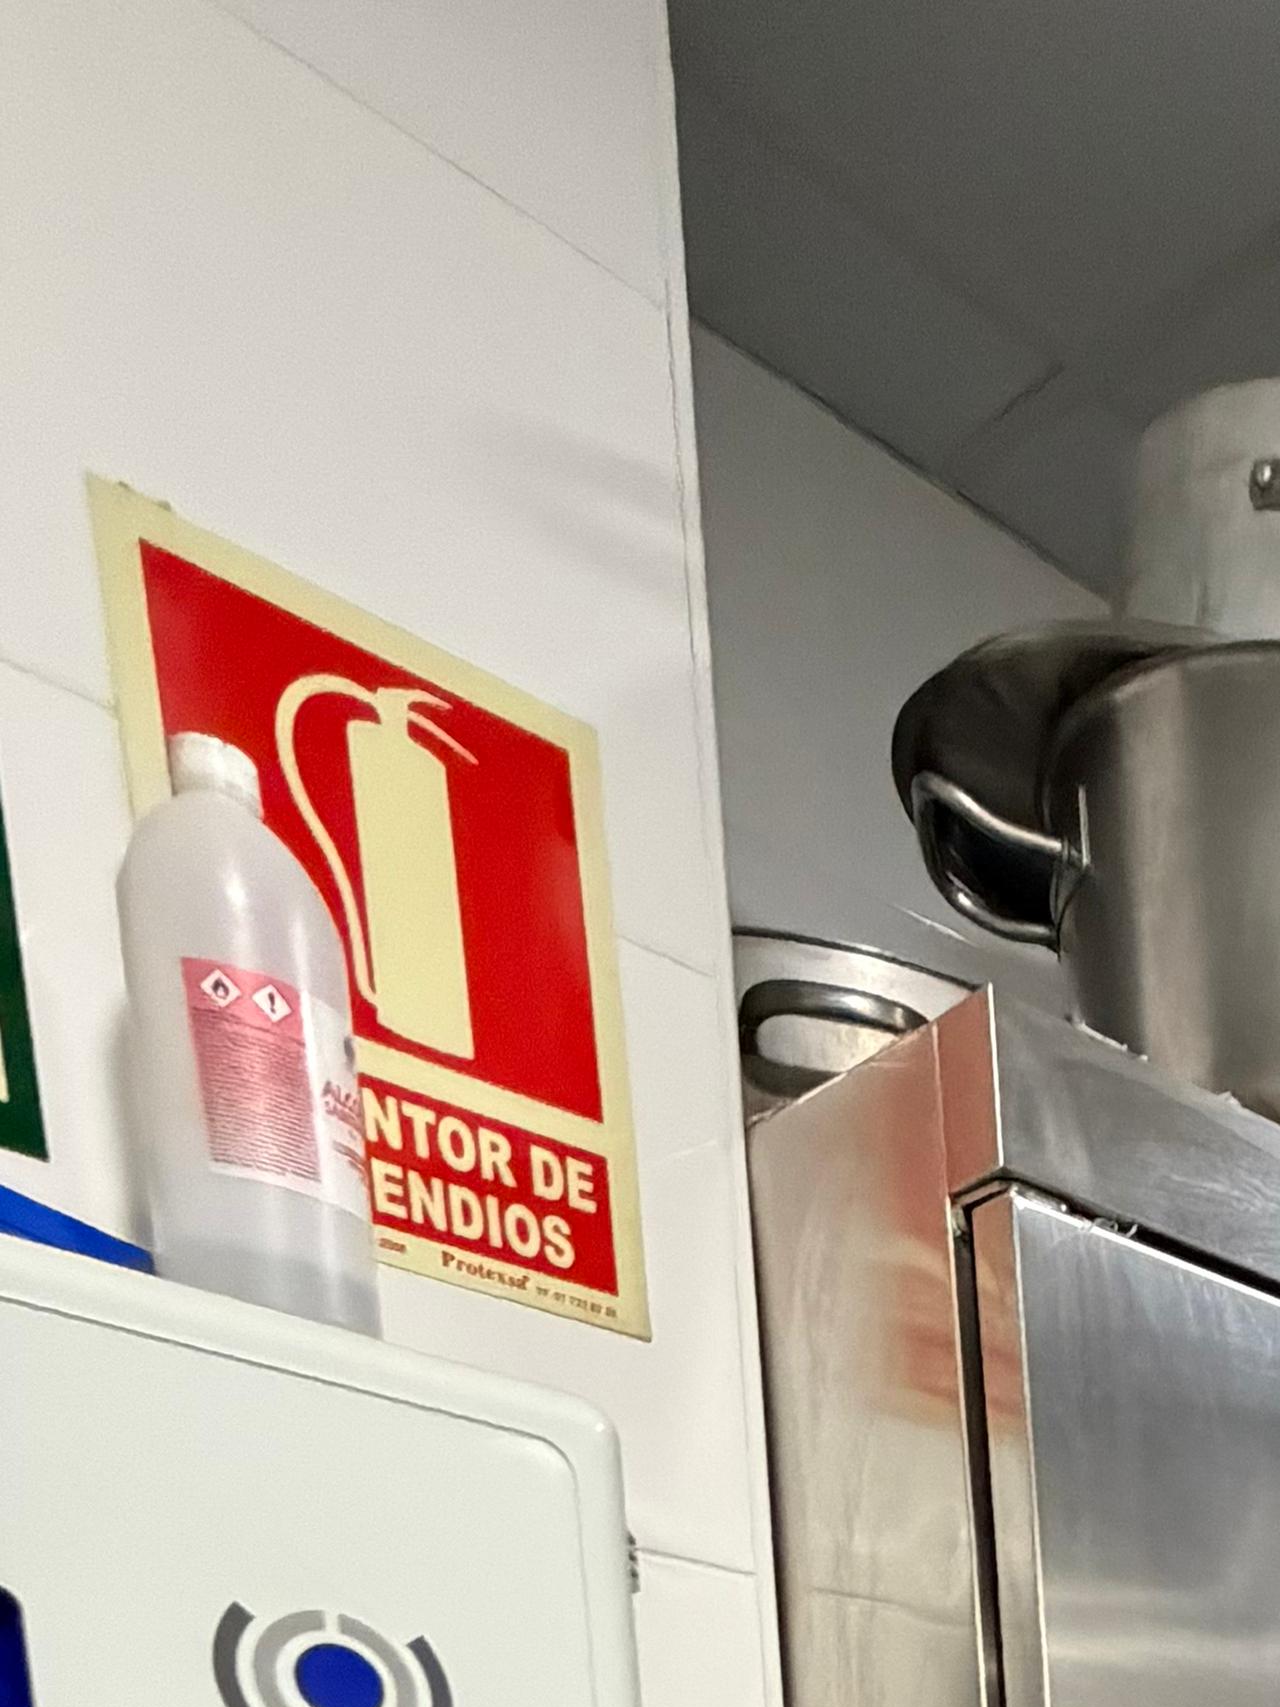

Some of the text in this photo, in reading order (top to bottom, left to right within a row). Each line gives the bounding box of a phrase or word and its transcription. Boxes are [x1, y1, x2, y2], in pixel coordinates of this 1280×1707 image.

[361, 1087, 517, 1188] NTOR
[530, 1144, 597, 1214] DE
[370, 1157, 576, 1269] ENDIOS
